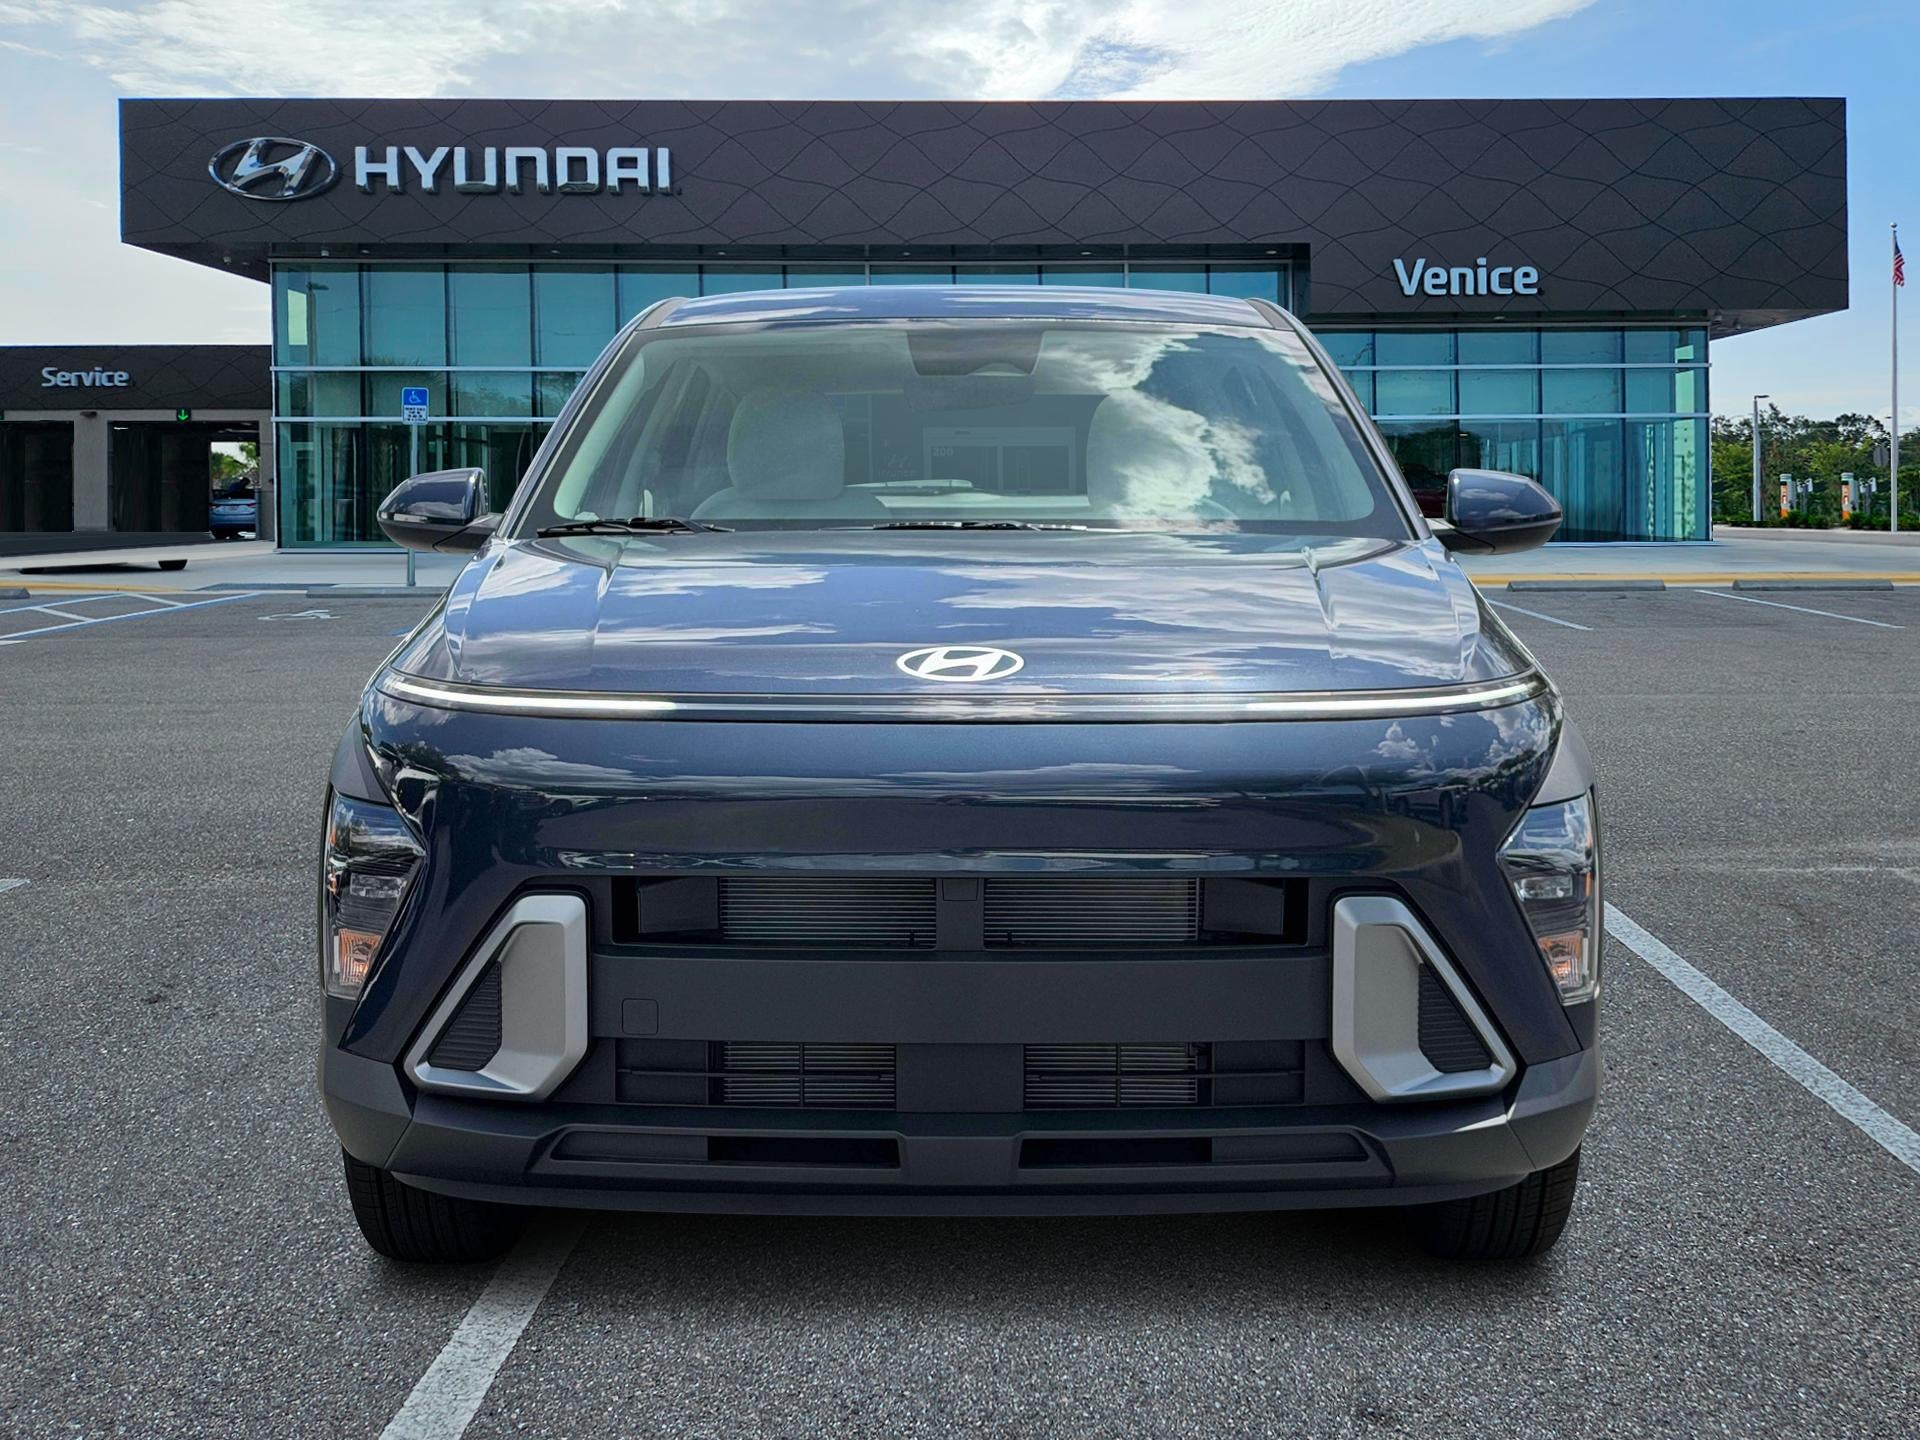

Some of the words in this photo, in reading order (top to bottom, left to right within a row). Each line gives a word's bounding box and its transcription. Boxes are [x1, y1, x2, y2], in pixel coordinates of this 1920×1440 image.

[354, 146, 671, 193] HYUNDAI
[1393, 257, 1539, 296] Venice
[41, 367, 130, 387] Service
